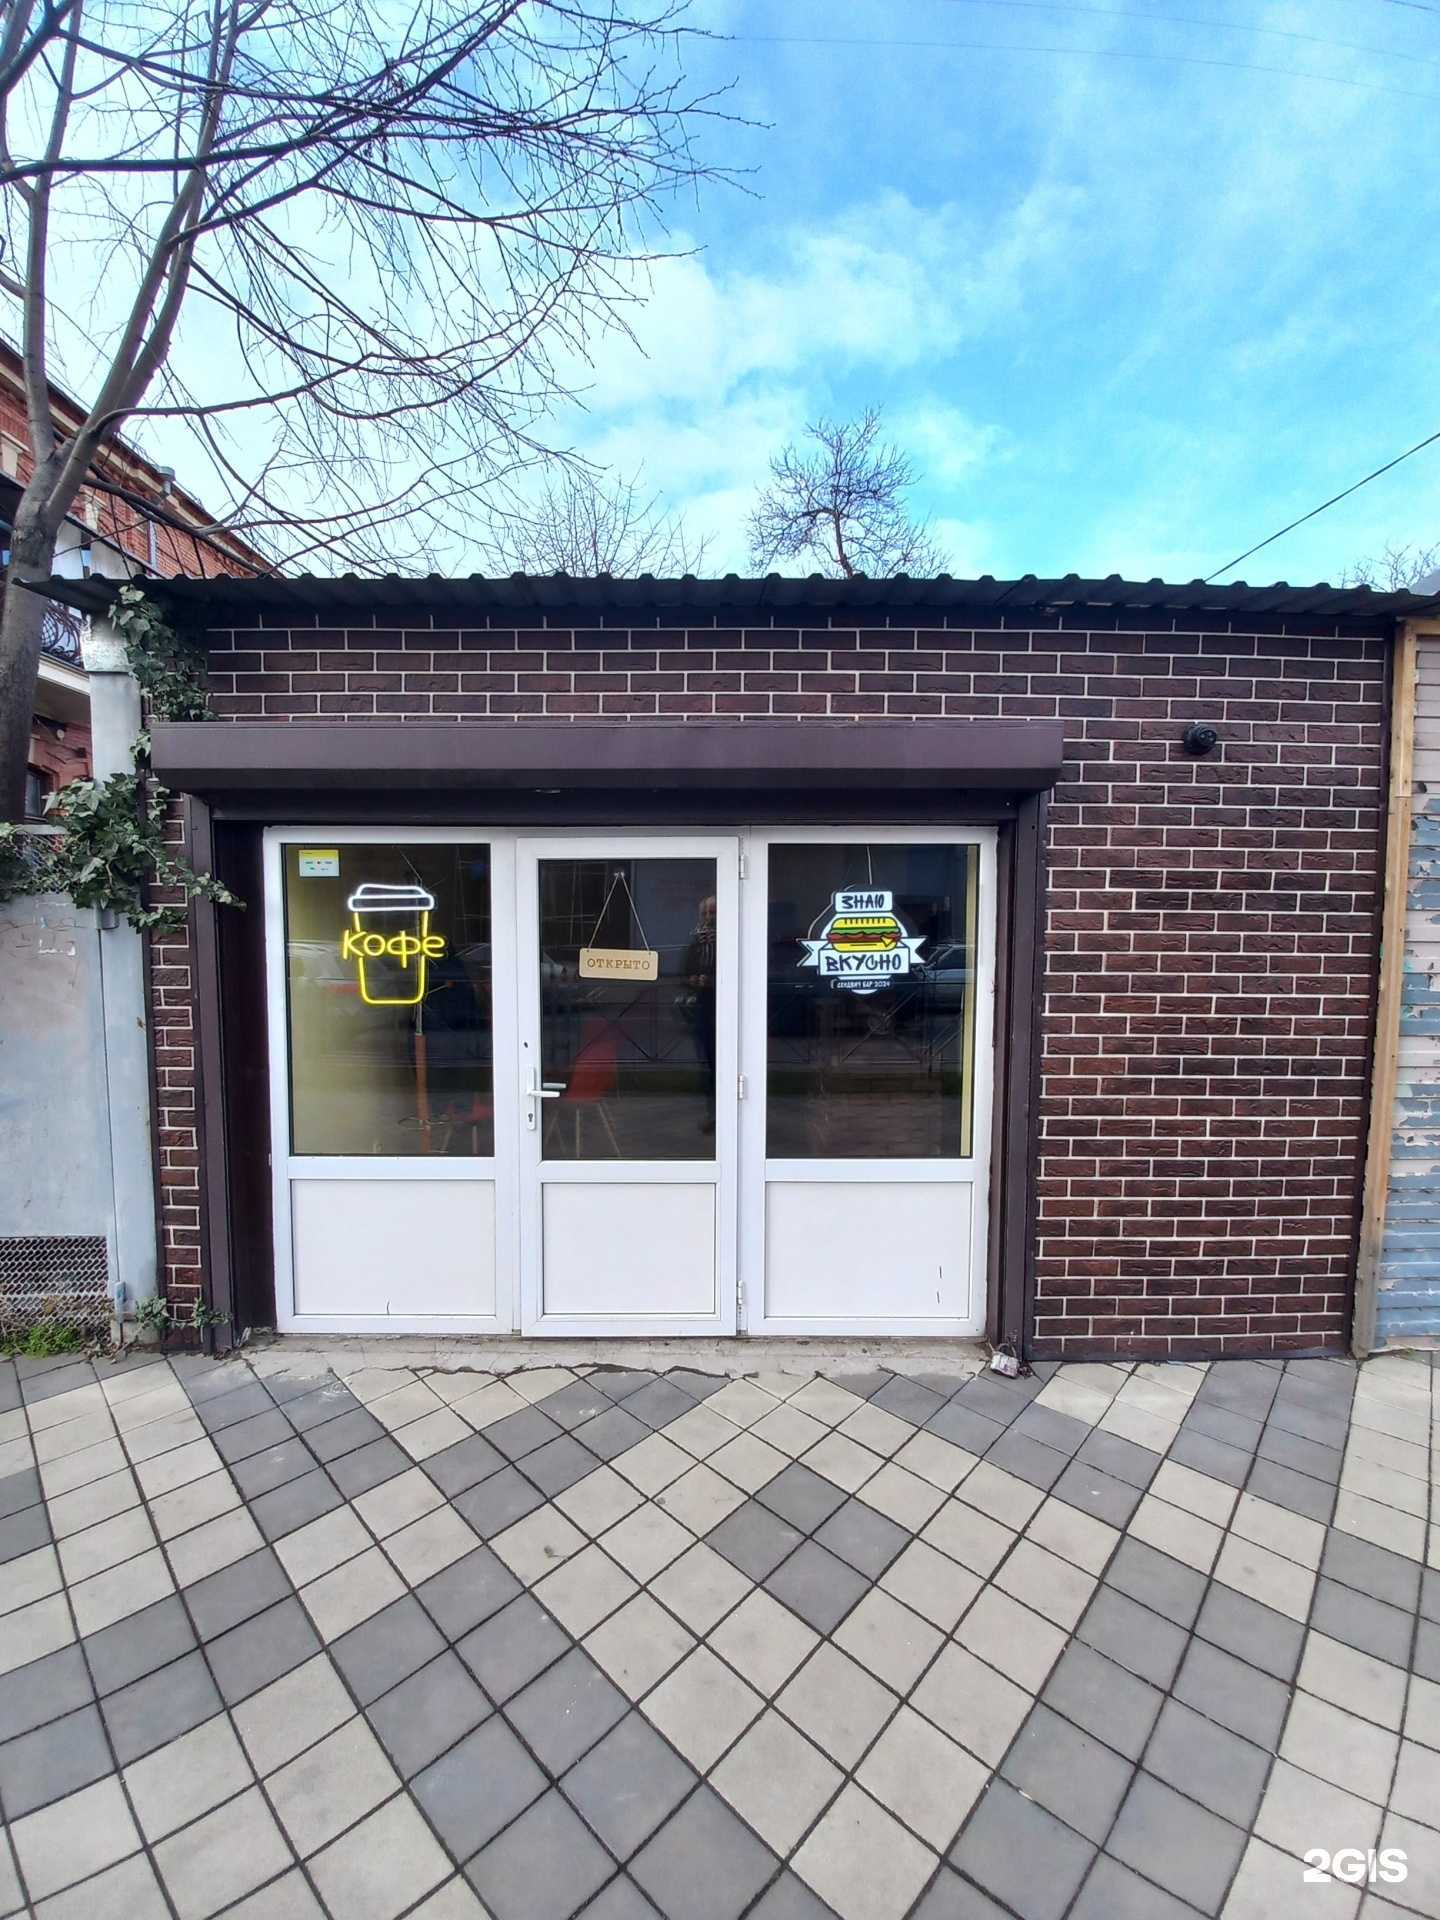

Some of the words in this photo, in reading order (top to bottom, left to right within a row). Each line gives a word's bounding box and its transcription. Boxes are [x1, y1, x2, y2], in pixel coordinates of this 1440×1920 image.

[840, 894, 885, 909] ЗНАЮ
[586, 958, 650, 970] ОТКРЫТО
[825, 954, 901, 972] ВКУСНО
